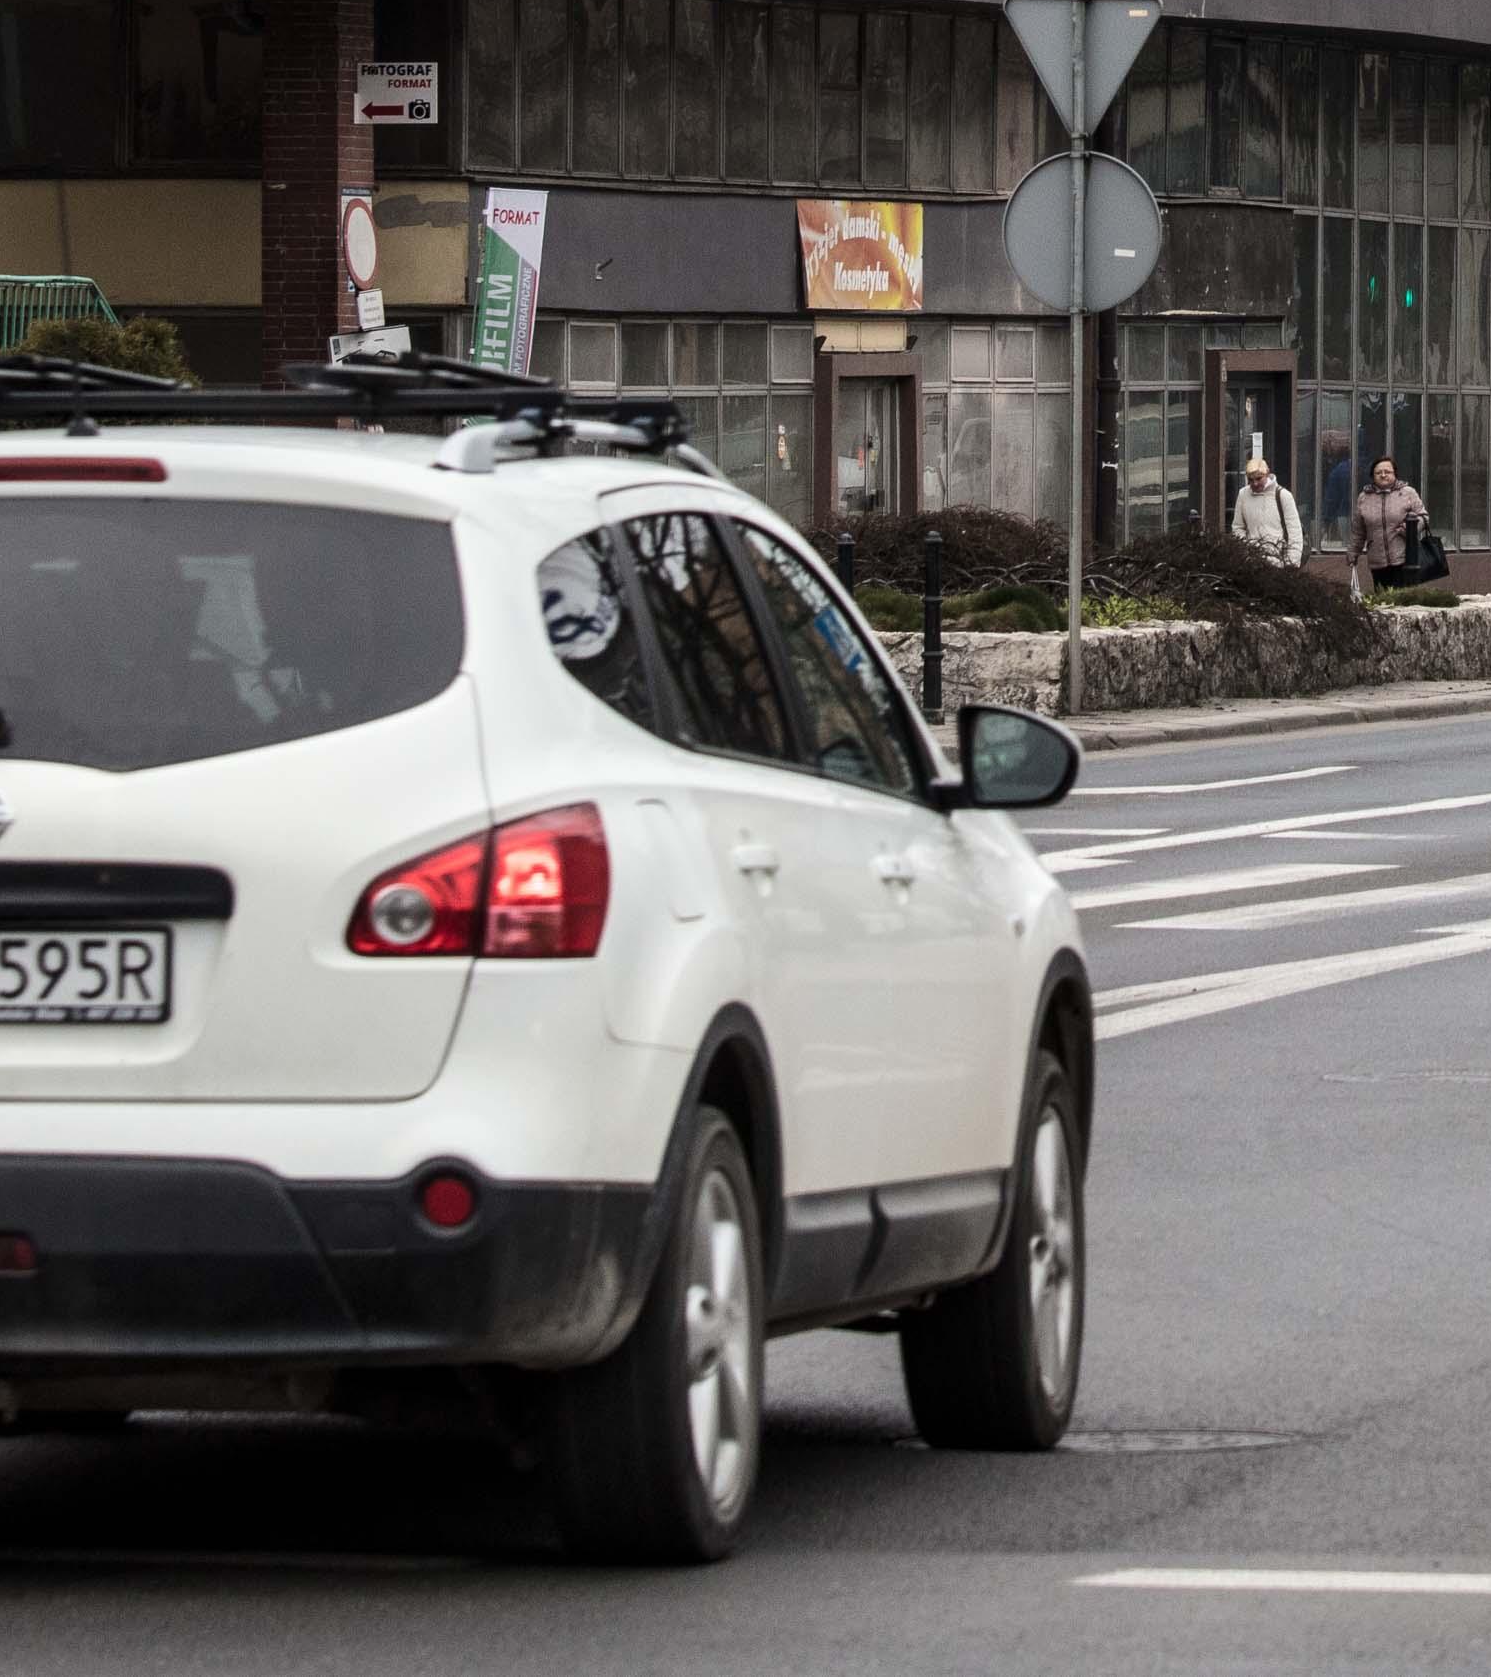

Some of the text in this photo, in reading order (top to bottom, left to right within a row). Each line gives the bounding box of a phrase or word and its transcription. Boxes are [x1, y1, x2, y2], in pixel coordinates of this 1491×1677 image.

[388, 79, 432, 89] FORMAT
[493, 208, 540, 225] FORMAT
[842, 209, 880, 241] damski
[834, 261, 889, 300] Kosmetyka
[515, 266, 533, 360] FOTOGRAFICZNE
